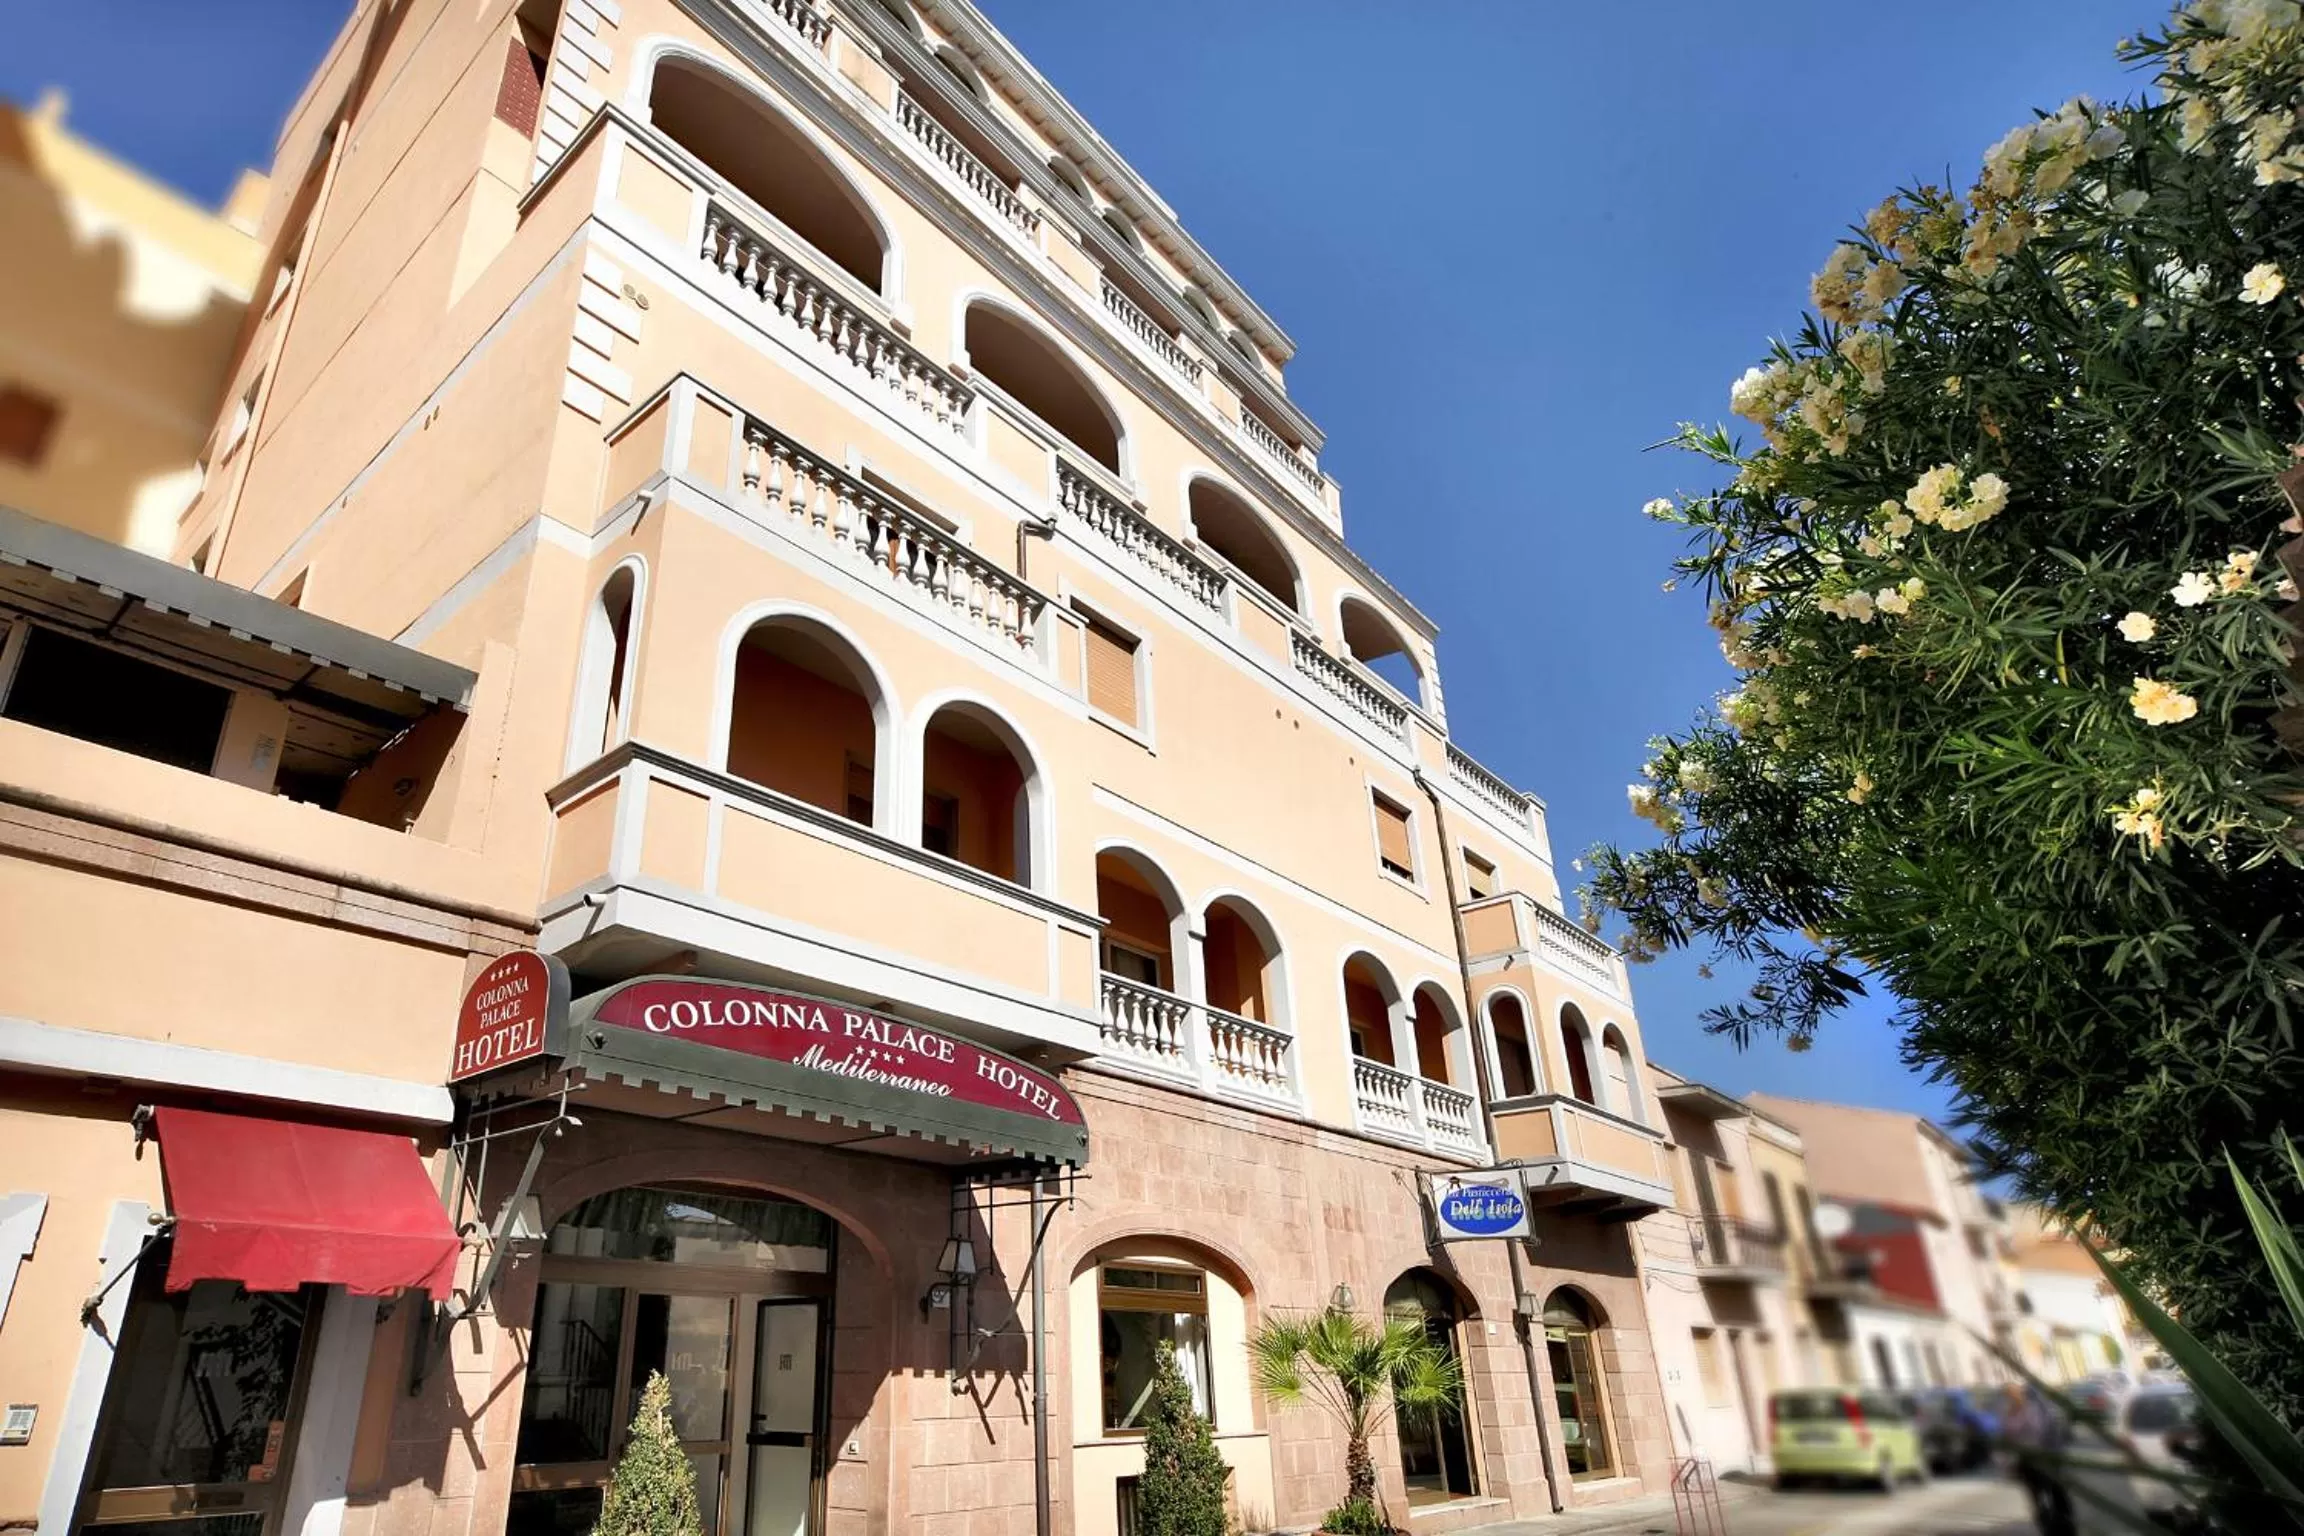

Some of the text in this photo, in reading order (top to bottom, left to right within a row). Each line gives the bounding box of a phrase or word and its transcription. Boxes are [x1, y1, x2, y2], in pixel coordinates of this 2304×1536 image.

[476, 975, 530, 1011] COLONNA
[480, 999, 522, 1029] PALACE
[456, 1017, 540, 1073] HOTEL
[643, 999, 1062, 1121] COLONNA PALACE HOTEL
[791, 1042, 954, 1098] Mediterraneo
